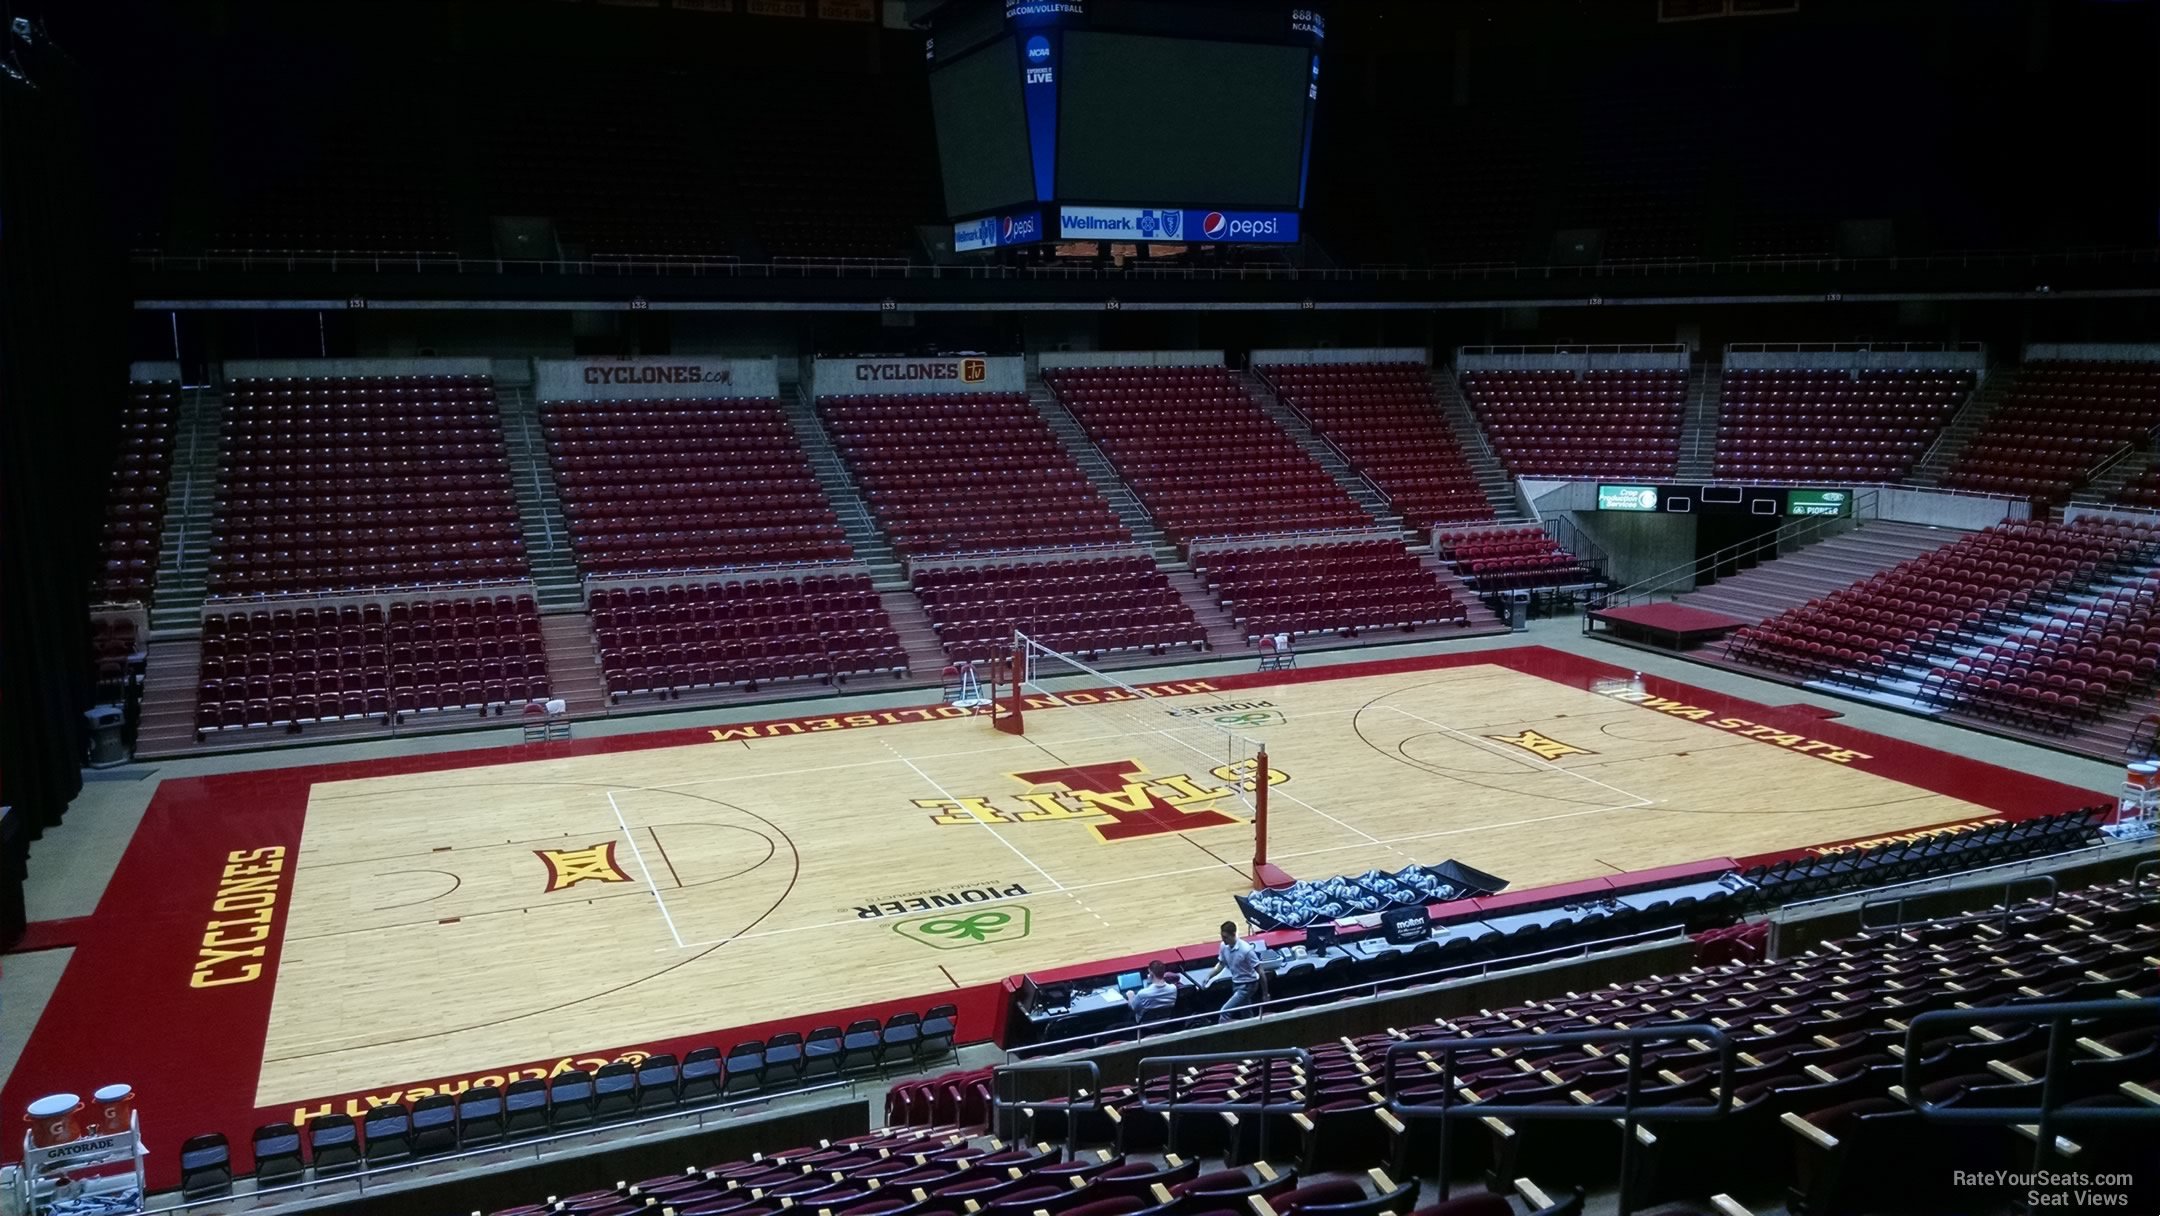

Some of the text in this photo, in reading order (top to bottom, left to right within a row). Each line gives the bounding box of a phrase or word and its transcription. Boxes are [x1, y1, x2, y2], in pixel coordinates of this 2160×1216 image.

[1029, 48, 1050, 57] NCAA
[1027, 73, 1053, 84] LIVE
[1013, 216, 1034, 239] pepsi
[1062, 215, 1132, 231] Wellmark
[1229, 217, 1278, 237] pepsi
[631, 301, 647, 309] 132
[882, 302, 896, 310] 133
[856, 363, 958, 381] CYCLONES
[1165, 700, 1278, 717] PIONEER
[1704, 717, 1874, 763] STATE
[852, 883, 1032, 919] PIONEER
[189, 846, 286, 989] CYCLONES
[1396, 917, 1425, 929] molten
[105, 1107, 116, 1119] G
[50, 1122, 63, 1136] G
[48, 1139, 114, 1159] GATORADE
